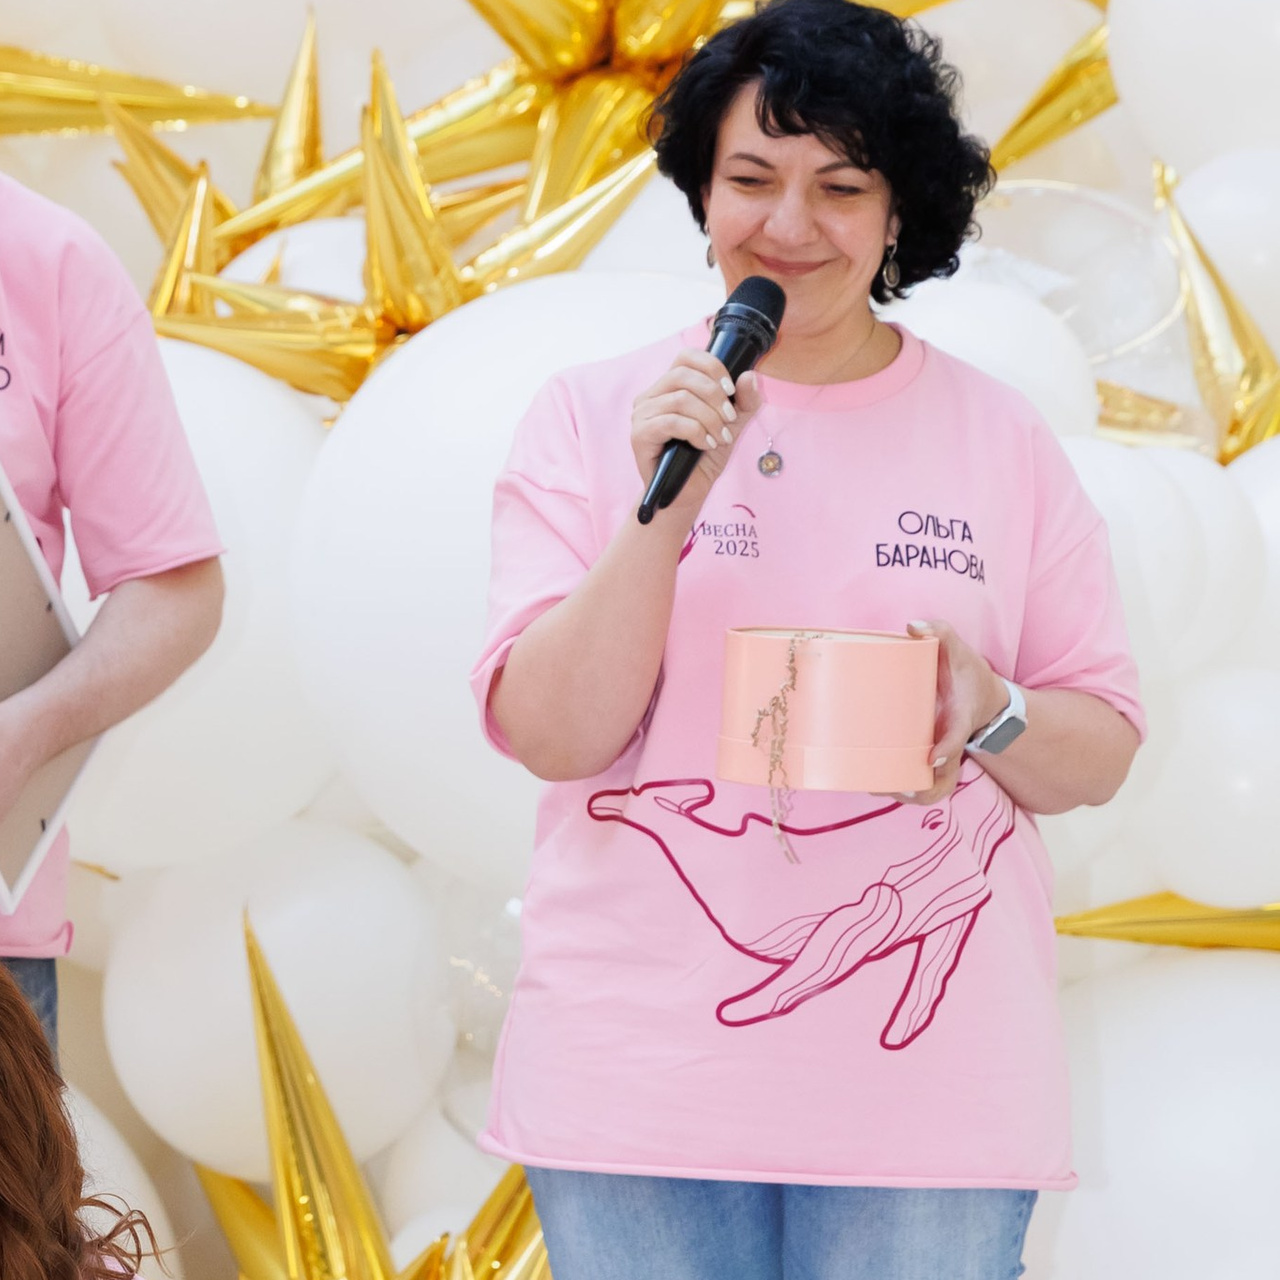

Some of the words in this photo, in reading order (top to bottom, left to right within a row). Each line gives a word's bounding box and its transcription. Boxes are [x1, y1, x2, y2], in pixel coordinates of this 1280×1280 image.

[702, 523, 758, 539] ВЕСНА
[898, 510, 974, 543] ОЛЬГА
[713, 540, 760, 558] 2025
[876, 543, 986, 586] БАРАНОВА
